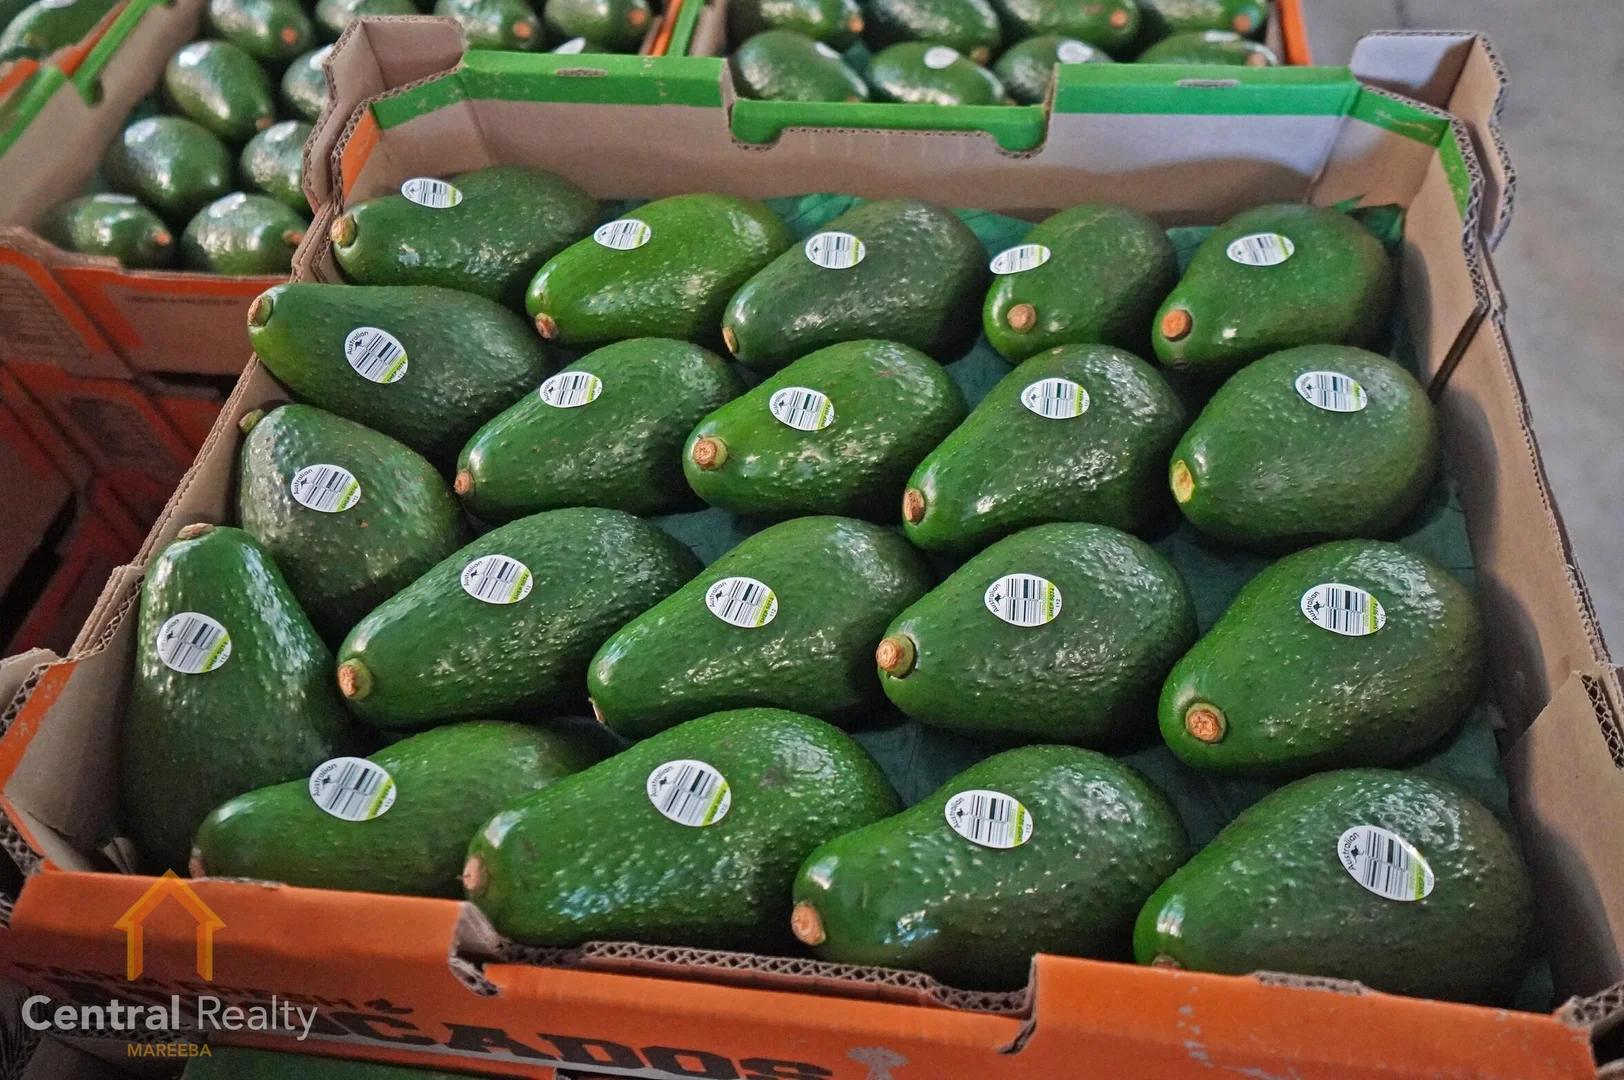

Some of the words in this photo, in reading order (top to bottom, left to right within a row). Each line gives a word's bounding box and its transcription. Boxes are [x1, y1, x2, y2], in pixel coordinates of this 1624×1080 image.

[346, 331, 369, 355] Australian
[774, 391, 787, 415] Australian
[293, 469, 313, 494] Australian
[464, 561, 482, 586] Australian
[709, 582, 727, 607] Australian
[988, 583, 1001, 612] Australian
[1306, 591, 1320, 621] Australian
[312, 763, 337, 796] Australian
[651, 765, 674, 797] Australian
[951, 797, 964, 828] Australian
[1344, 832, 1361, 871] Australian
